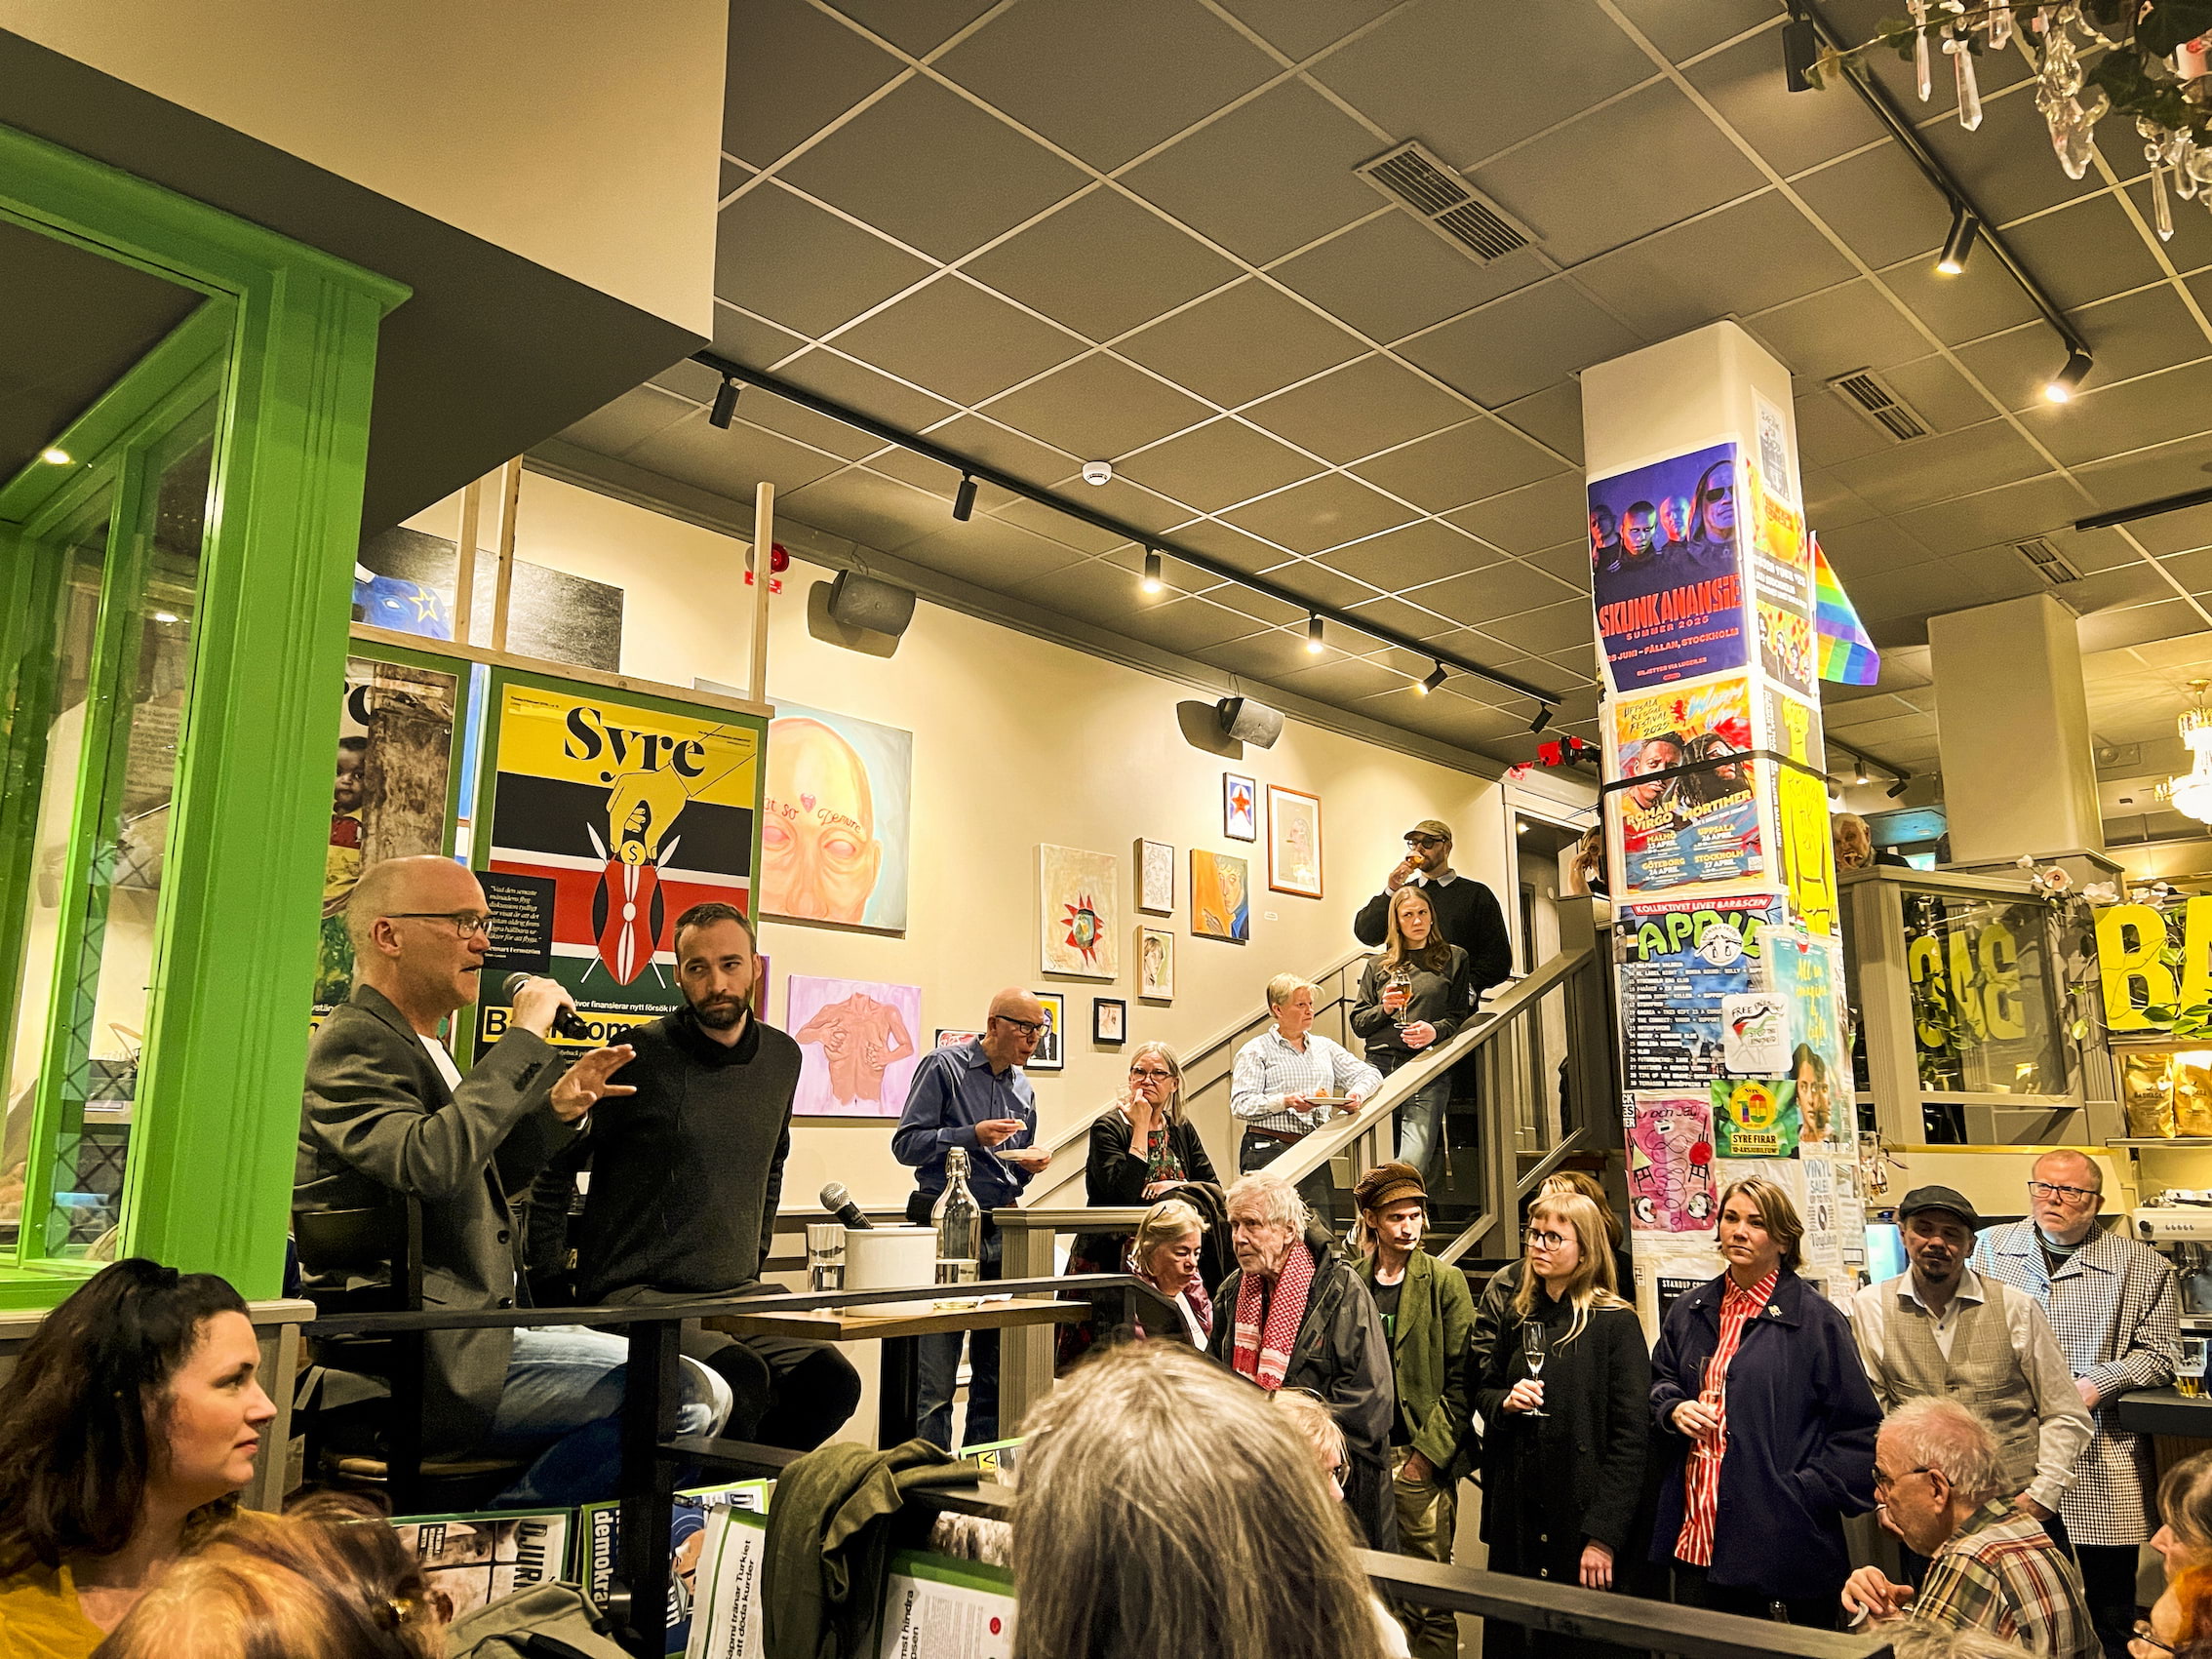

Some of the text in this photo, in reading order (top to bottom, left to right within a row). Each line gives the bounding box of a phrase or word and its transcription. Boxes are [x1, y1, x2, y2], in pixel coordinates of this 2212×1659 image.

[1626, 624, 1675, 641] SUMMER
[1617, 650, 1639, 661] JUNI
[1681, 627, 1740, 646] STOCKHOLM
[1630, 711, 1667, 733] FESTIVAL
[1643, 722, 1671, 737] 2025
[565, 706, 705, 783] Syre
[1626, 795, 1679, 826] ROMAIN
[1681, 790, 1752, 821] MORTIMER
[1633, 810, 1674, 832] VIRGO
[1697, 823, 1736, 836] UPPSALA
[1646, 830, 1678, 843] MALMÖ
[1712, 831, 1734, 840] APRIL
[1641, 858, 1686, 870] GÖTEBORG
[1694, 849, 1745, 863] STOCKHOLM
[1714, 858, 1737, 867] APRIL
[1658, 866, 1680, 875] APRIL
[1635, 897, 1768, 914] KOLLEKTIVET LIVET BAR&SCEN
[591, 1000, 629, 1009] finansierar
[629, 1003, 645, 1011] nytt
[1731, 1006, 1753, 1018] FREE
[1650, 1107, 1674, 1119] och
[1737, 1093, 1767, 1123] 10
[1733, 1134, 1777, 1144] SYRE FIRAR
[1802, 1159, 1833, 1179] VINYL
[1662, 1280, 1690, 1288] STANDUP
[735, 1539, 751, 1581] Turkiet
[742, 1560, 755, 1600] kurder
[731, 1587, 741, 1623] tränar
[901, 1590, 914, 1634] hindra
[738, 1600, 748, 1635] döda
